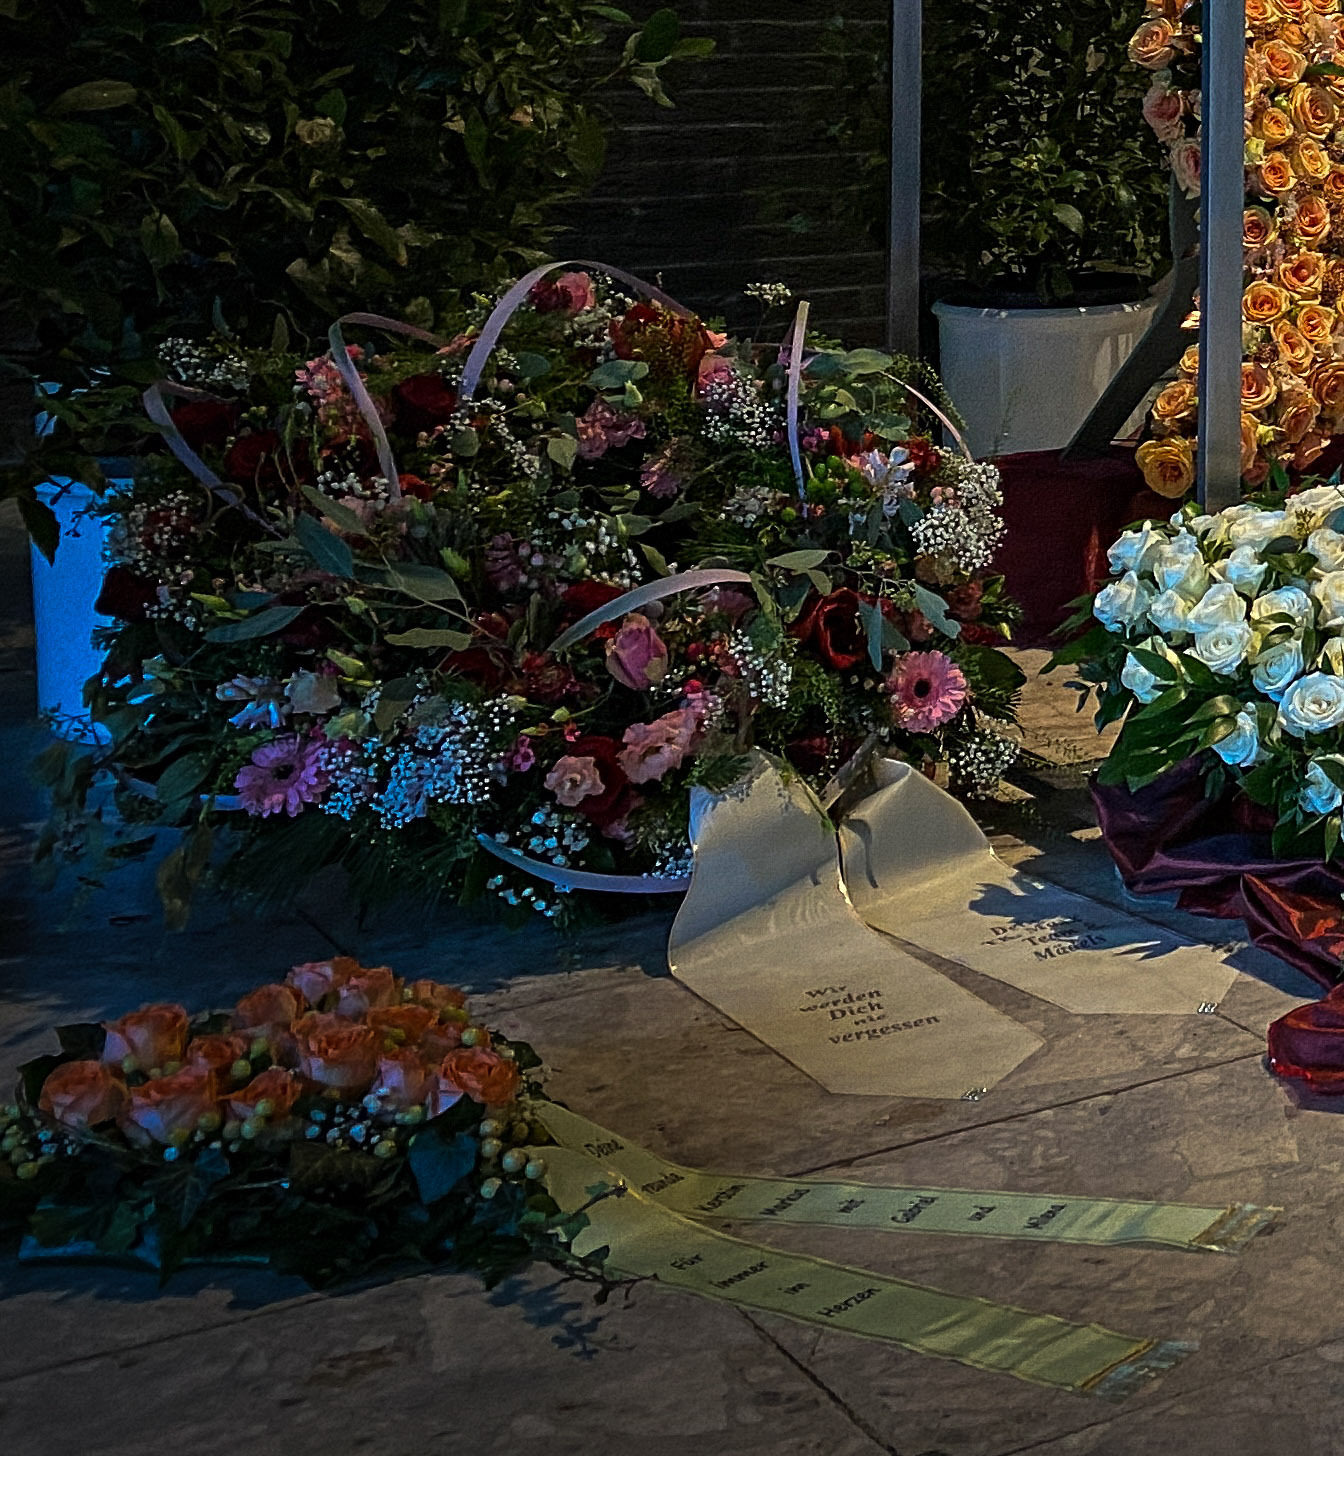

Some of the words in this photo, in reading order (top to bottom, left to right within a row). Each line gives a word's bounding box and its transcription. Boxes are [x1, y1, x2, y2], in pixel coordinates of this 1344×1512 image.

[799, 989, 883, 1013] werden
[805, 985, 847, 999] Wir
[829, 1000, 885, 1021] Dich
[853, 1013, 887, 1026] nie
[828, 1015, 941, 1045] vergessen
[670, 1253, 704, 1271] Für
[708, 1260, 769, 1289] immer
[816, 1288, 883, 1318] Herzen
